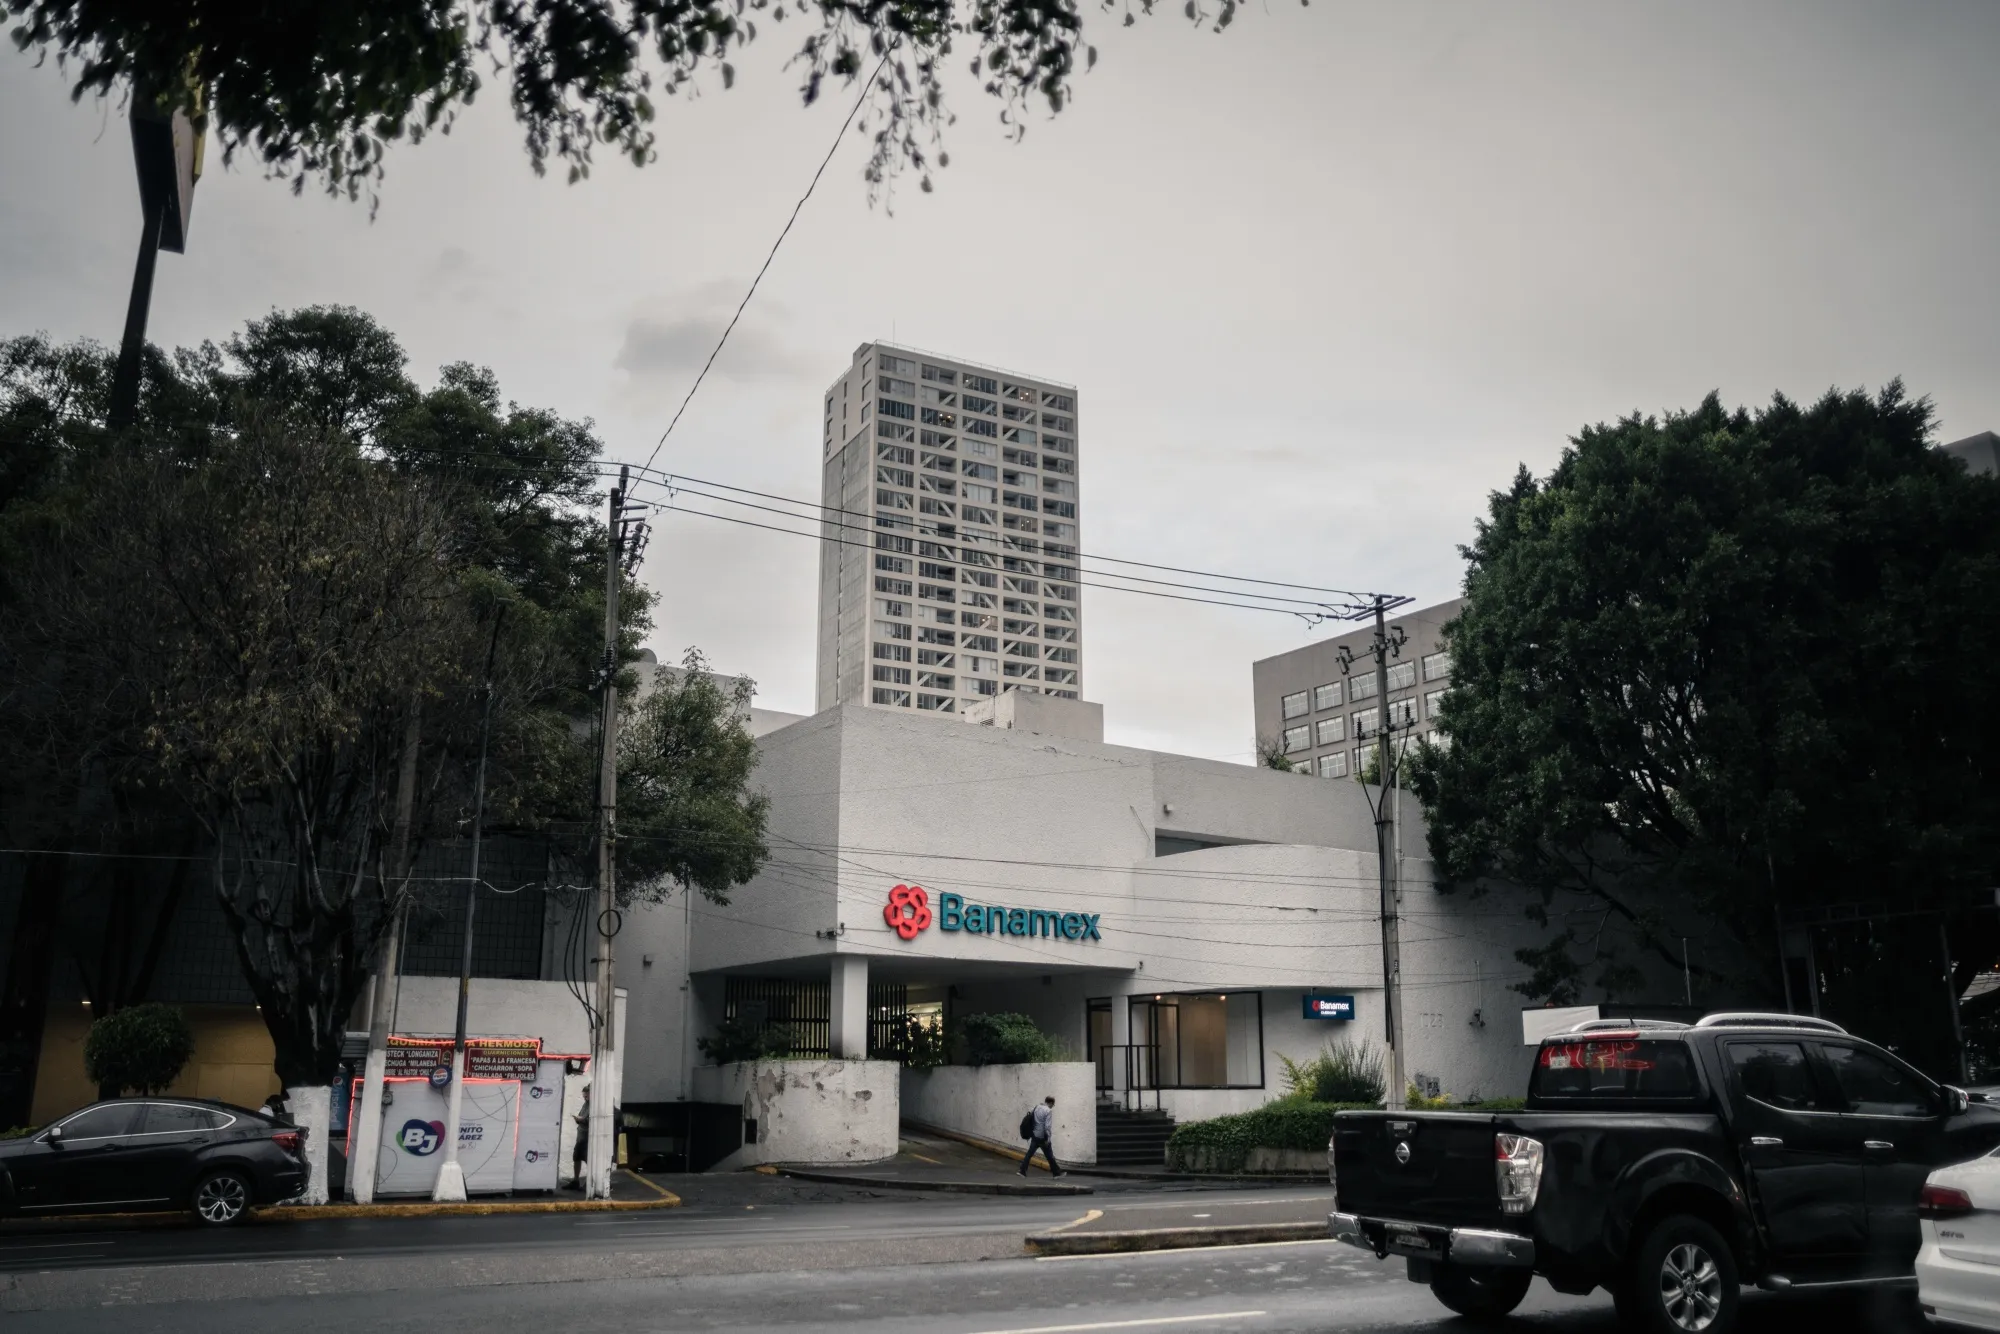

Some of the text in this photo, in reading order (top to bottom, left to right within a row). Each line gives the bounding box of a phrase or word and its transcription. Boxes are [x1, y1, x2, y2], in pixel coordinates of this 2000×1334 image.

[940, 892, 1101, 940] Banamex
[1320, 1000, 1349, 1010] Banamex
[402, 1128, 438, 1153] BJ
